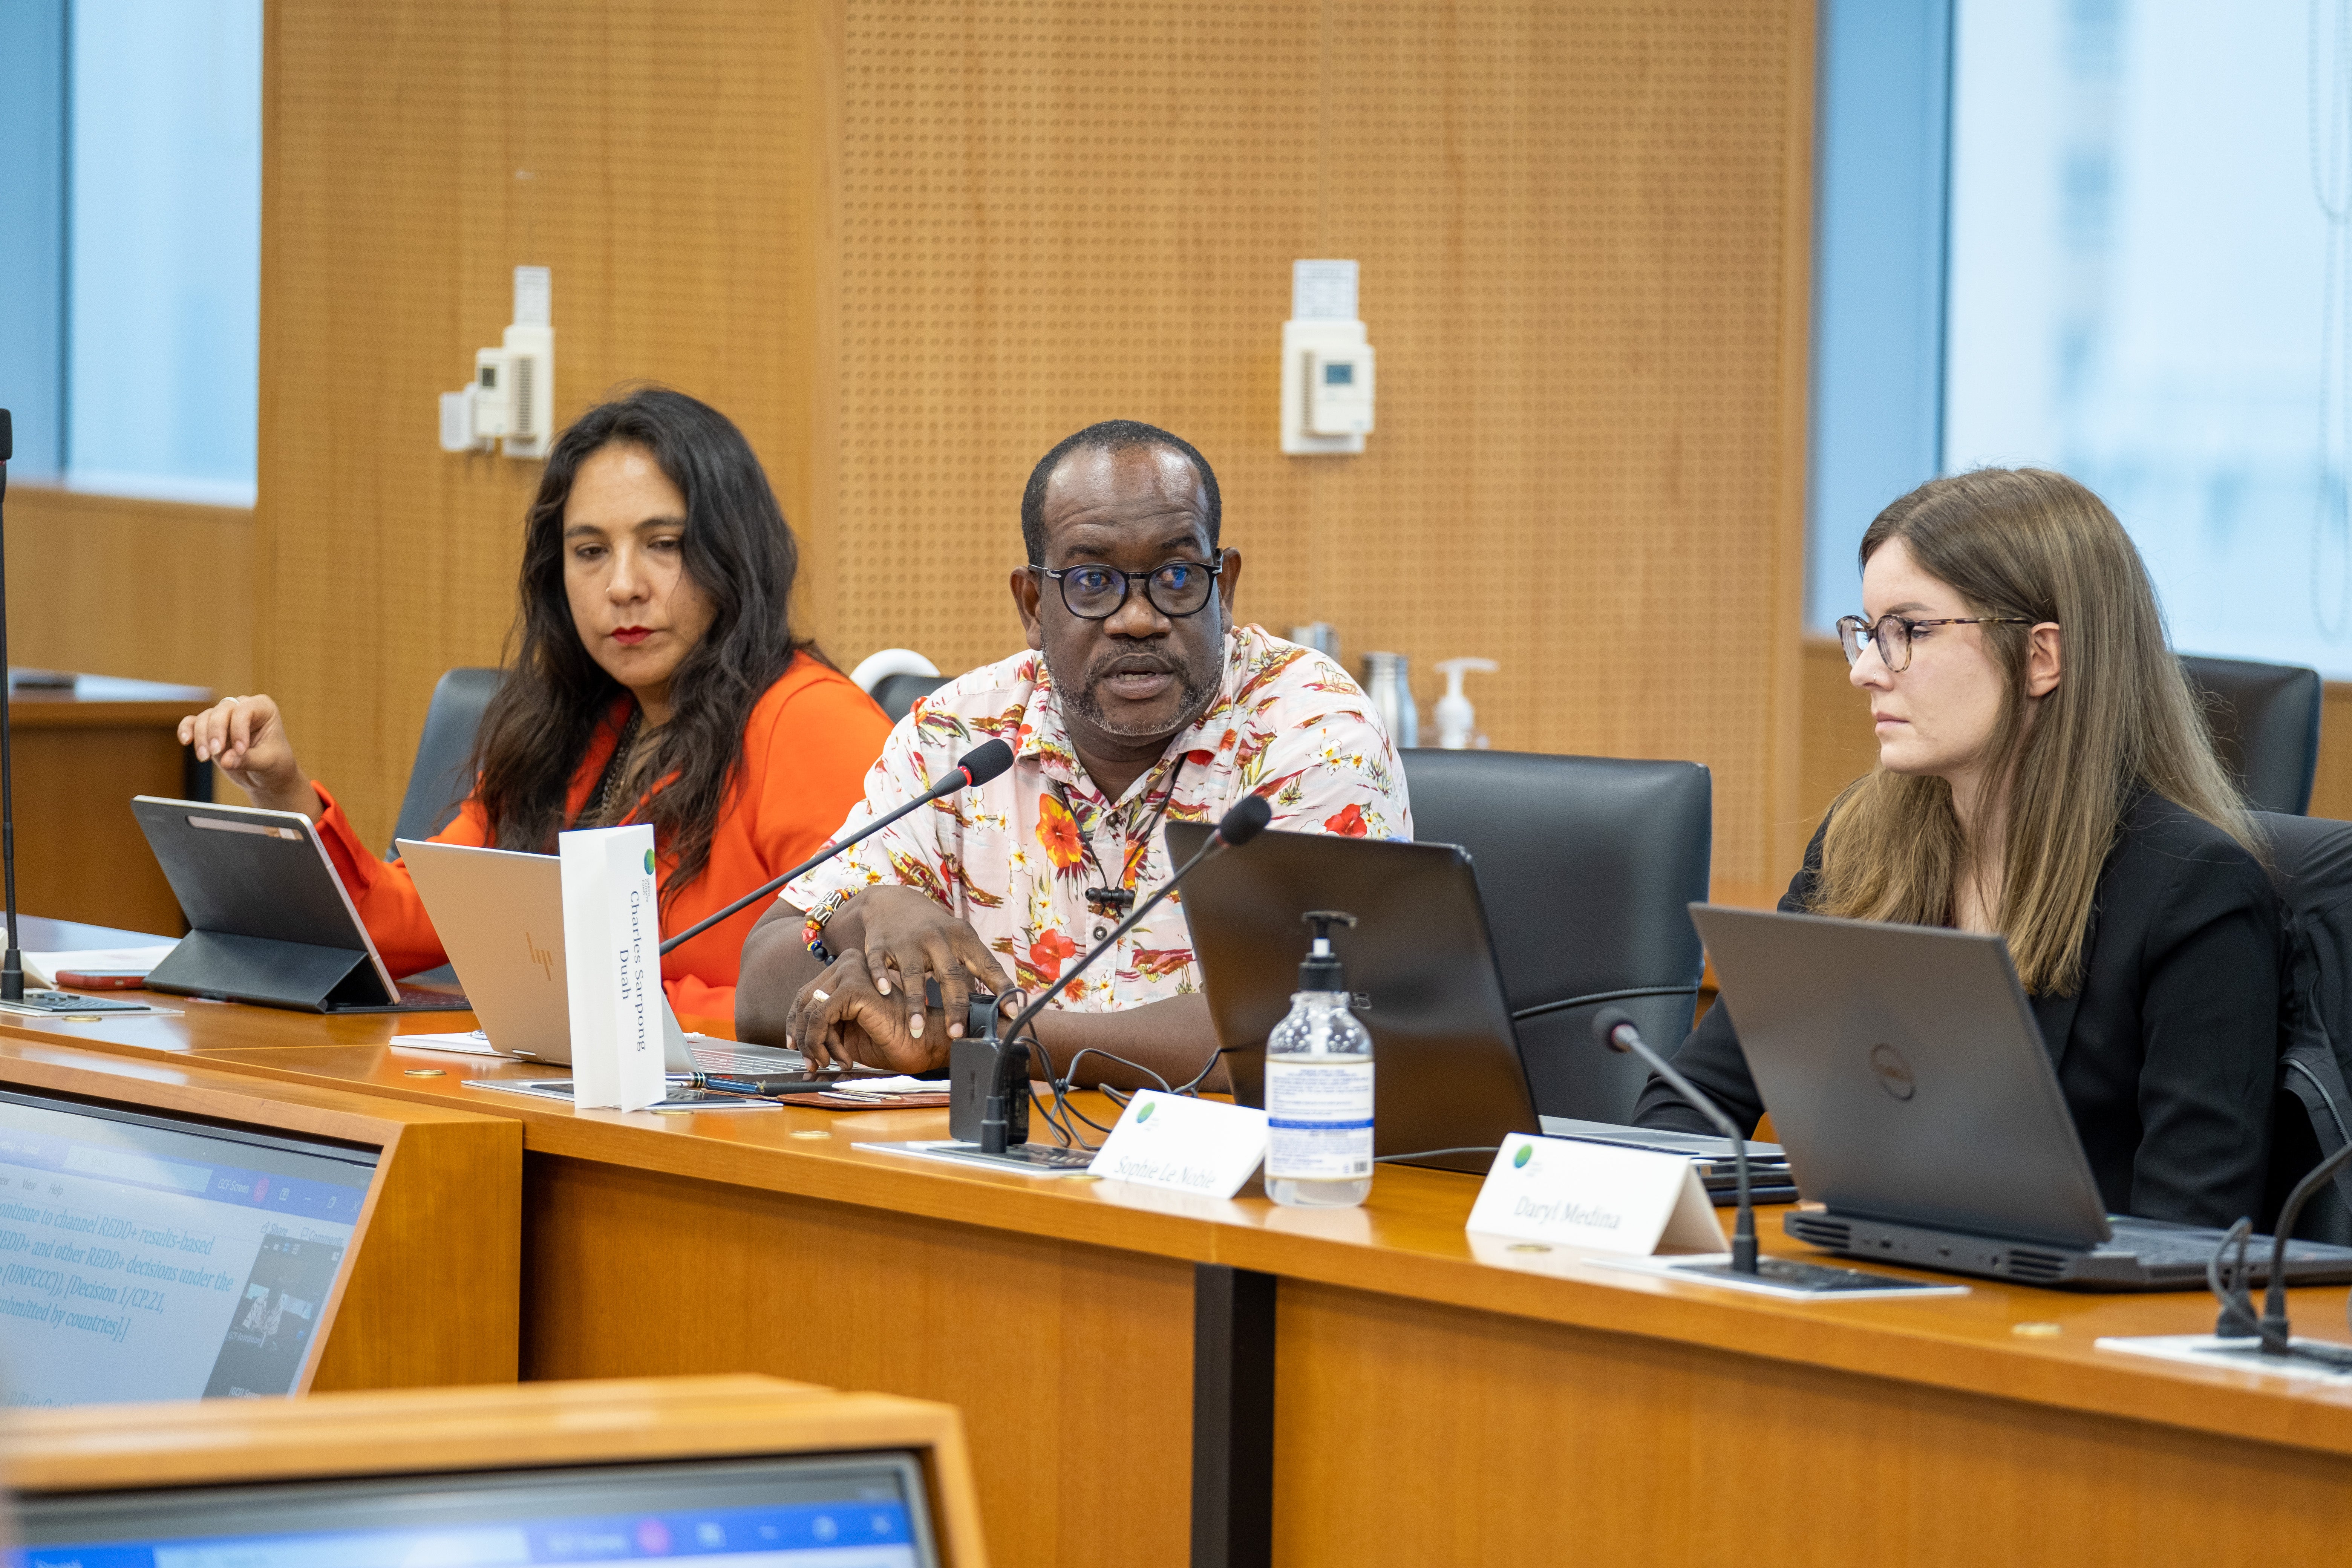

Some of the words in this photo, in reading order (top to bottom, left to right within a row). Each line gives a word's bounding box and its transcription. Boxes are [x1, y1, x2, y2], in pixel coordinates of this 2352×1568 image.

[630, 890, 642, 963] Charles
[525, 932, 553, 981] hp
[619, 949, 631, 1000] Duah
[635, 969, 645, 1052] Sarpong
[22, 1178, 37, 1191] View
[218, 1178, 231, 1190] GCF
[230, 1180, 250, 1194] Screen
[1113, 1155, 1159, 1181] Sophie
[1158, 1162, 1177, 1182] Le
[1176, 1165, 1216, 1188] Noble
[48, 1183, 63, 1199] Help
[0, 1202, 40, 1222] ontinue
[41, 1208, 54, 1225] to
[54, 1208, 100, 1234] channel
[98, 1216, 137, 1239] REDD+
[138, 1228, 216, 1256] results-based
[269, 1223, 289, 1237] Share
[1513, 1195, 1562, 1225] Daryl
[1560, 1202, 1622, 1230] Medina
[308, 1230, 345, 1246] Comments
[31, 1239, 57, 1258] and
[54, 1242, 86, 1263] other
[85, 1246, 125, 1269] REDD+
[126, 1254, 179, 1282] decisions
[179, 1266, 215, 1288] under
[214, 1270, 234, 1292] the
[0, 1295, 51, 1321] ubmitted
[50, 1303, 66, 1329] by
[63, 1275, 118, 1302] [Decision
[118, 1286, 165, 1314] 1/CP.21,
